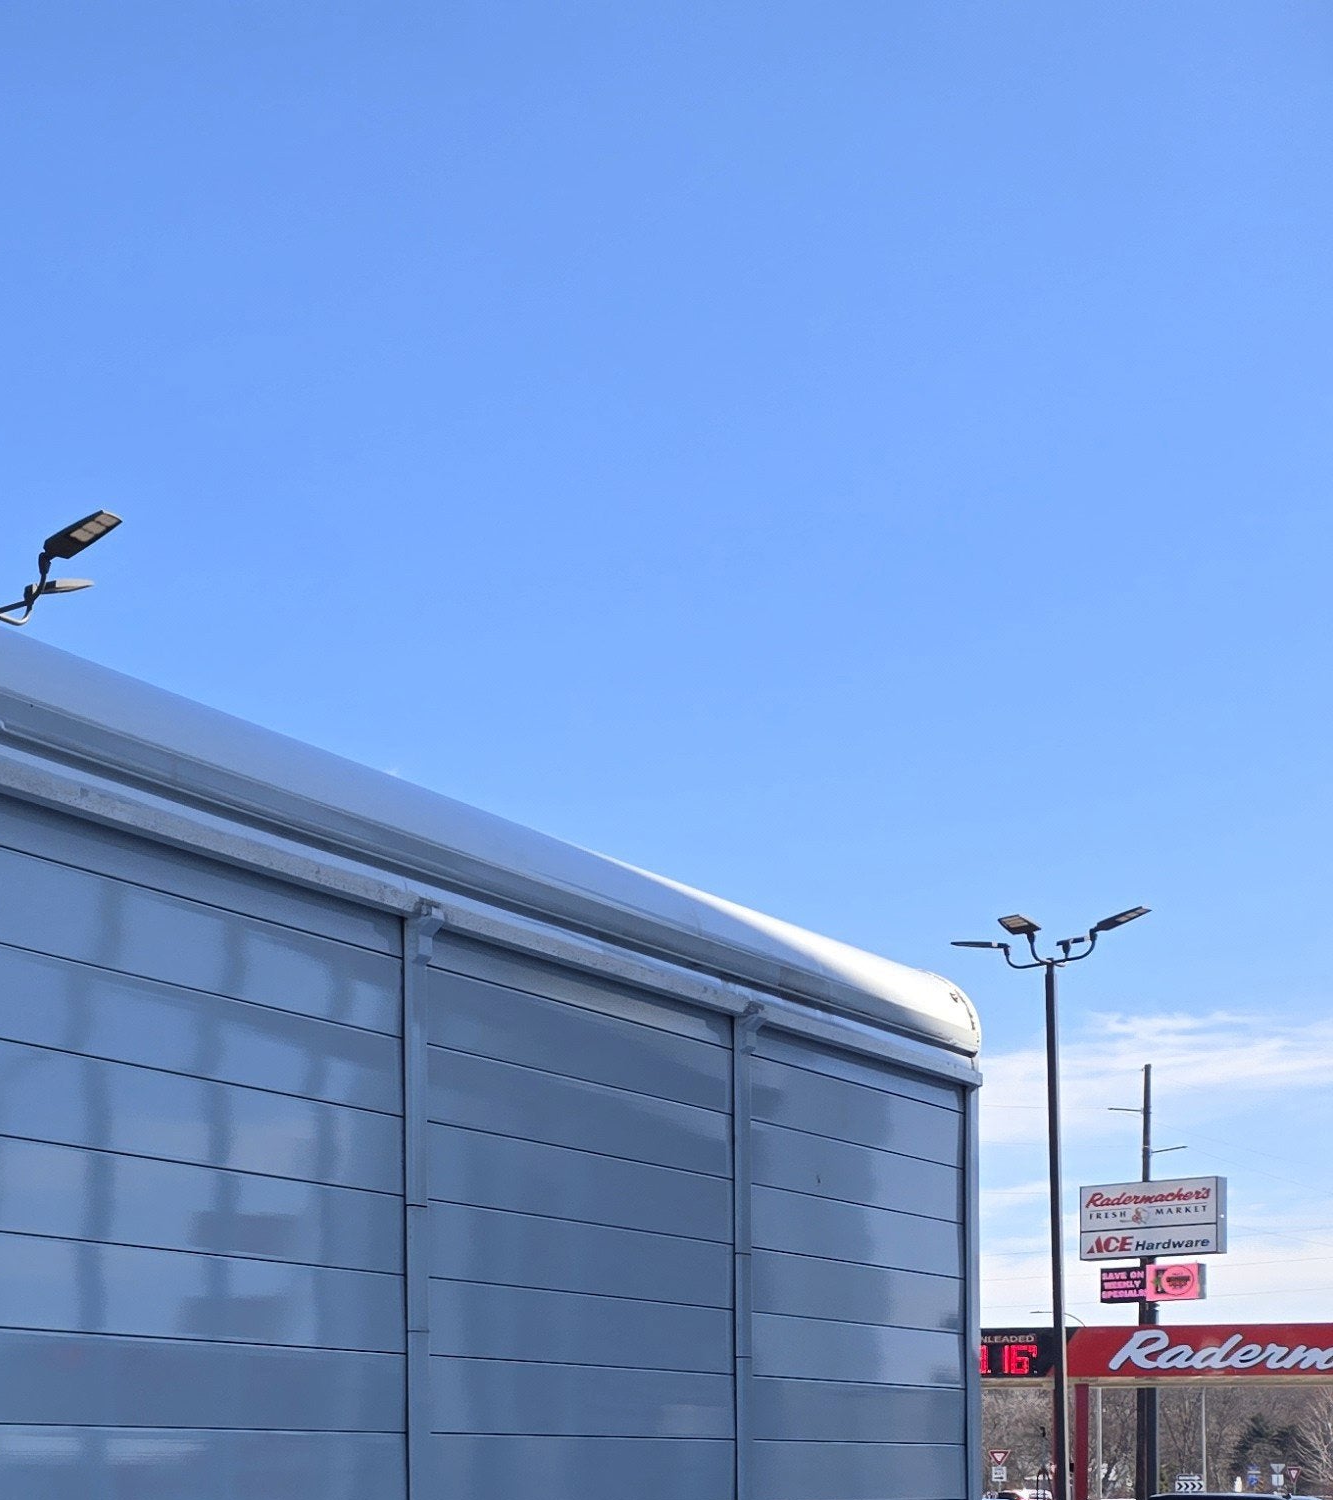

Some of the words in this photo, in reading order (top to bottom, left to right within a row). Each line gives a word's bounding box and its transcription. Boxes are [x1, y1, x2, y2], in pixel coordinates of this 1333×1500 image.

[1085, 1187, 1211, 1209] Radermacher's
[1089, 1210, 1127, 1220] FRESH
[1154, 1204, 1208, 1216] MARKET
[1086, 1235, 1134, 1255] ACE
[1134, 1238, 1210, 1252] Hardware
[1130, 1270, 1145, 1279] ON
